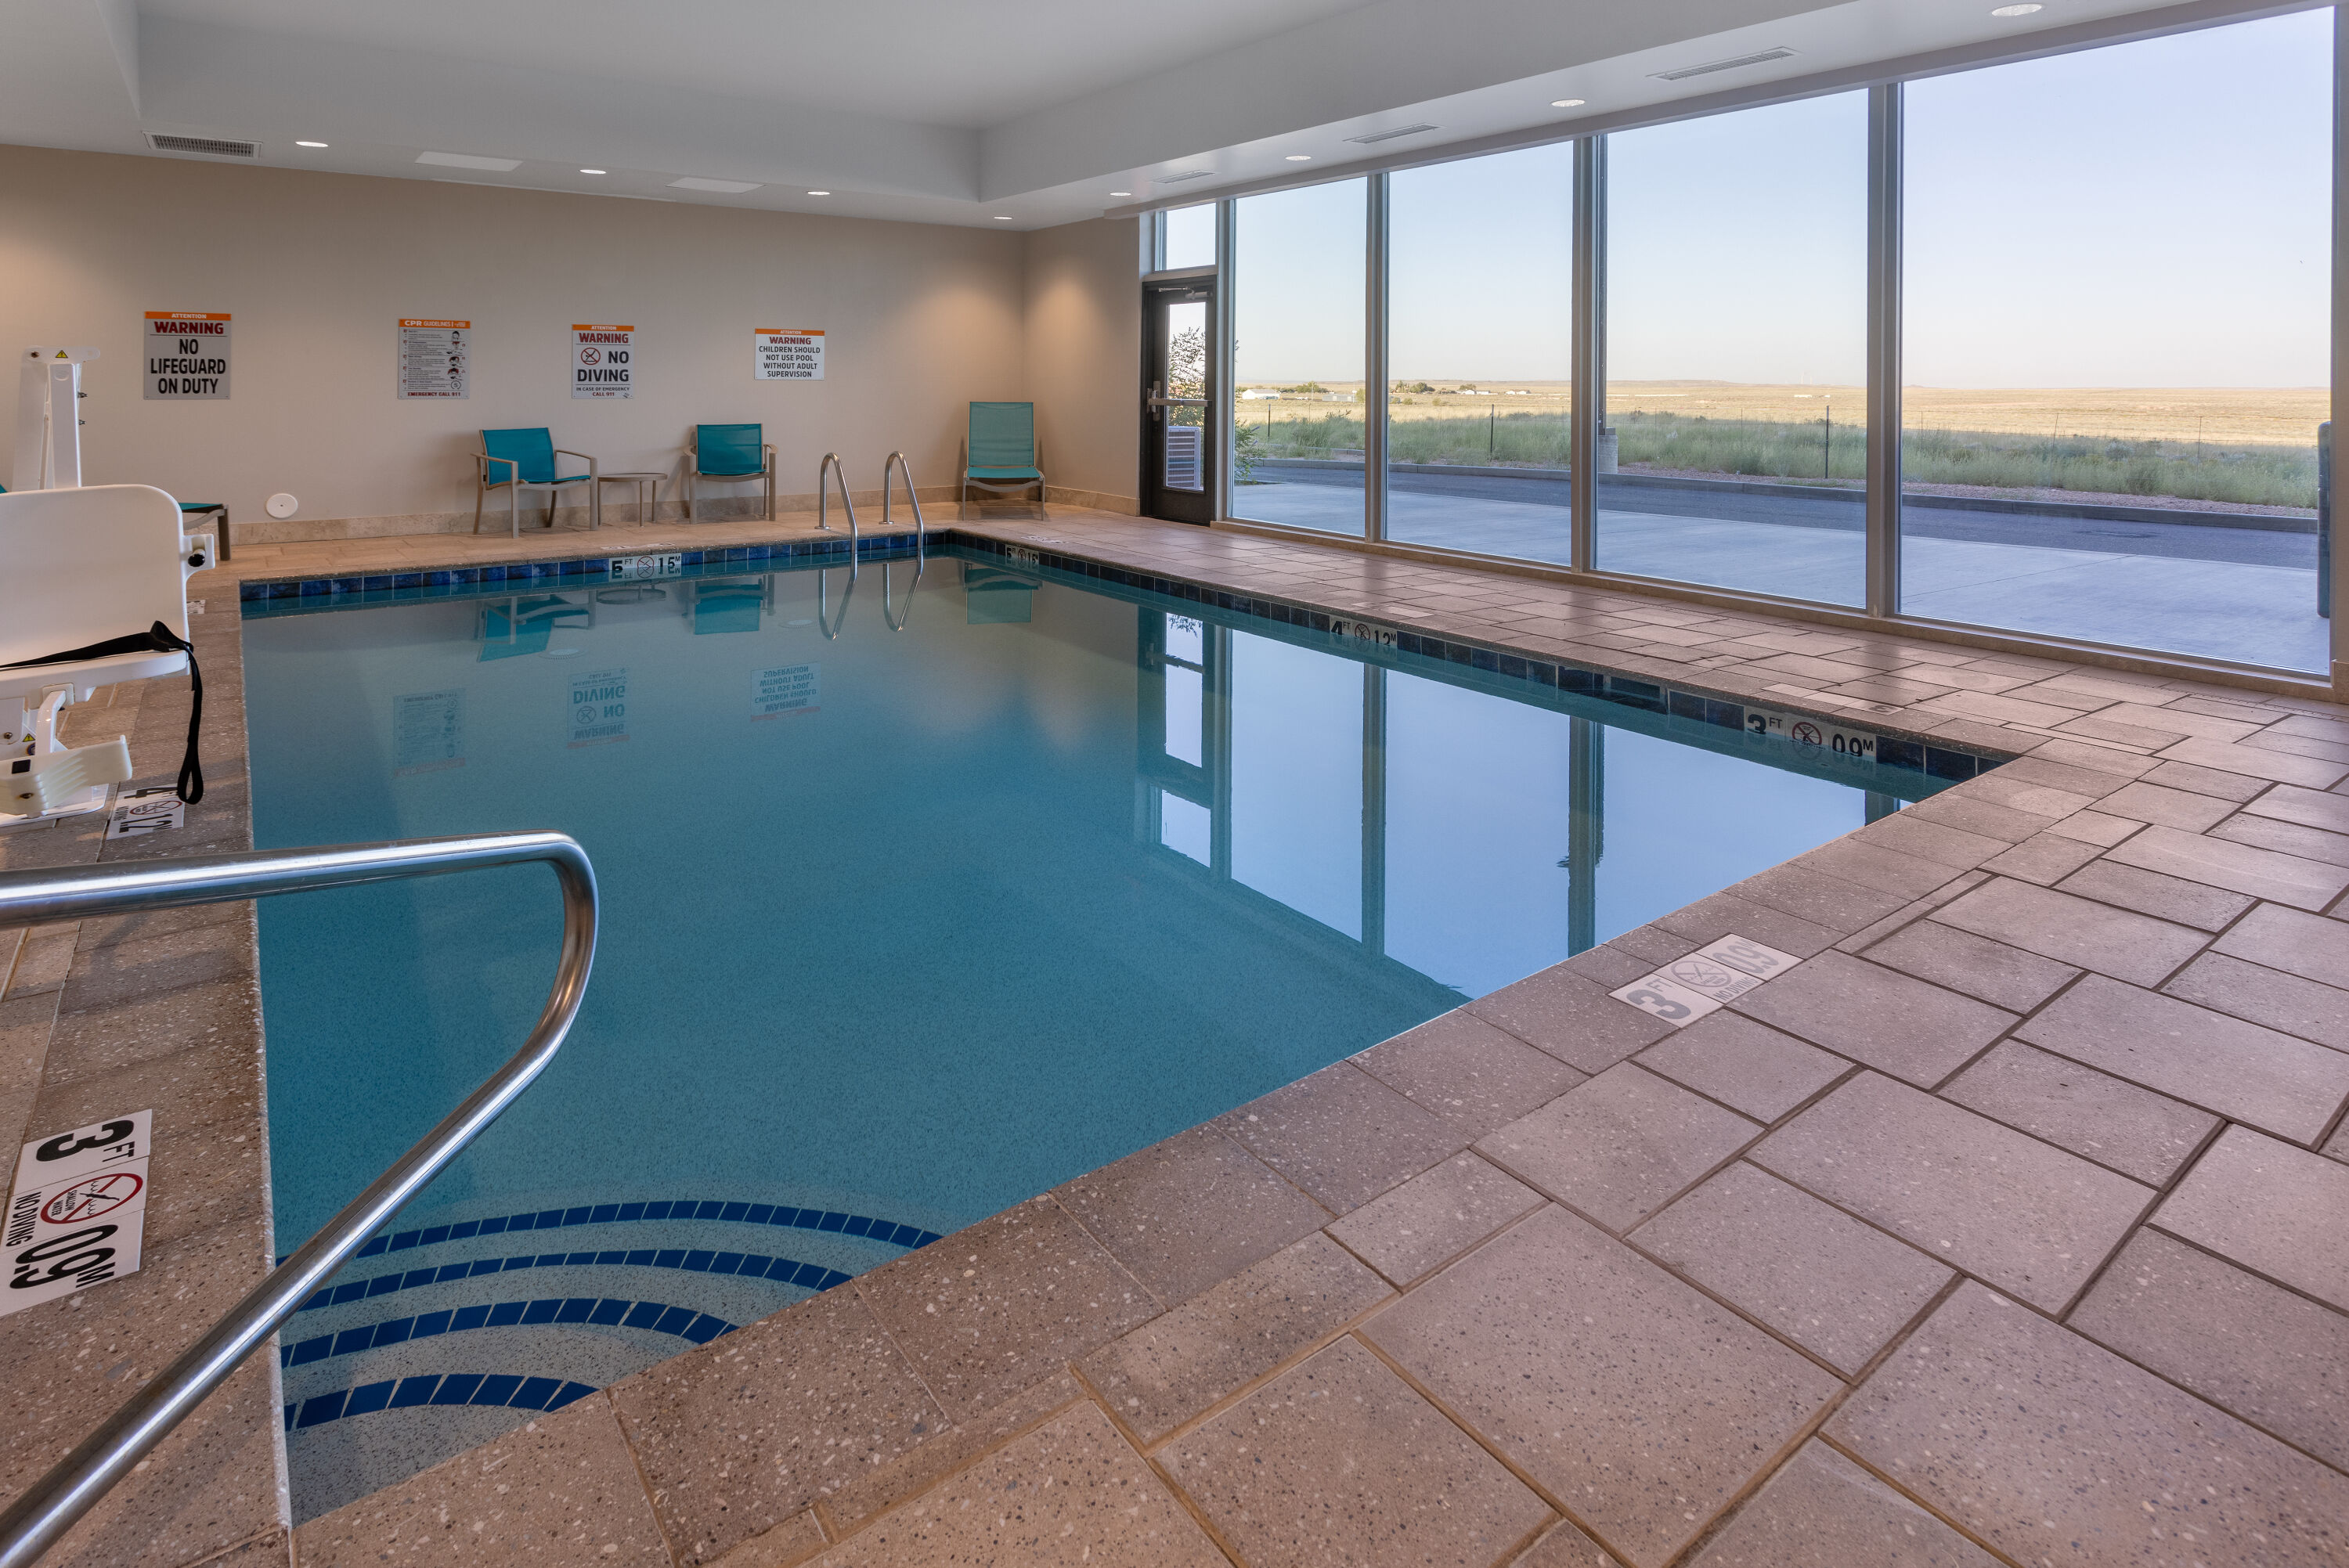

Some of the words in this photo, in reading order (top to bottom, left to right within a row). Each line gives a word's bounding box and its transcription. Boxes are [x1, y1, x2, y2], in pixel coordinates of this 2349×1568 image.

[154, 322, 224, 334] WARNING
[579, 333, 629, 344] WARNING
[179, 339, 198, 355] NO
[608, 351, 629, 363] NO
[150, 359, 226, 374] LIFEGUARD
[578, 369, 629, 382] DIVING
[158, 378, 178, 394] ON
[182, 378, 218, 394] DUTY
[612, 561, 623, 570] 5
[1331, 621, 1343, 636] 4
[1748, 714, 1766, 734] 3
[1769, 717, 1782, 729] FT
[1626, 989, 1691, 1020] 3
[36, 1119, 135, 1162] 3
[102, 1141, 135, 1162] FT
[14, 1191, 42, 1210] NO
[52, 1199, 64, 1217] WATER
[64, 1190, 77, 1212] SHALLOW
[6, 1211, 39, 1247] DIVING
